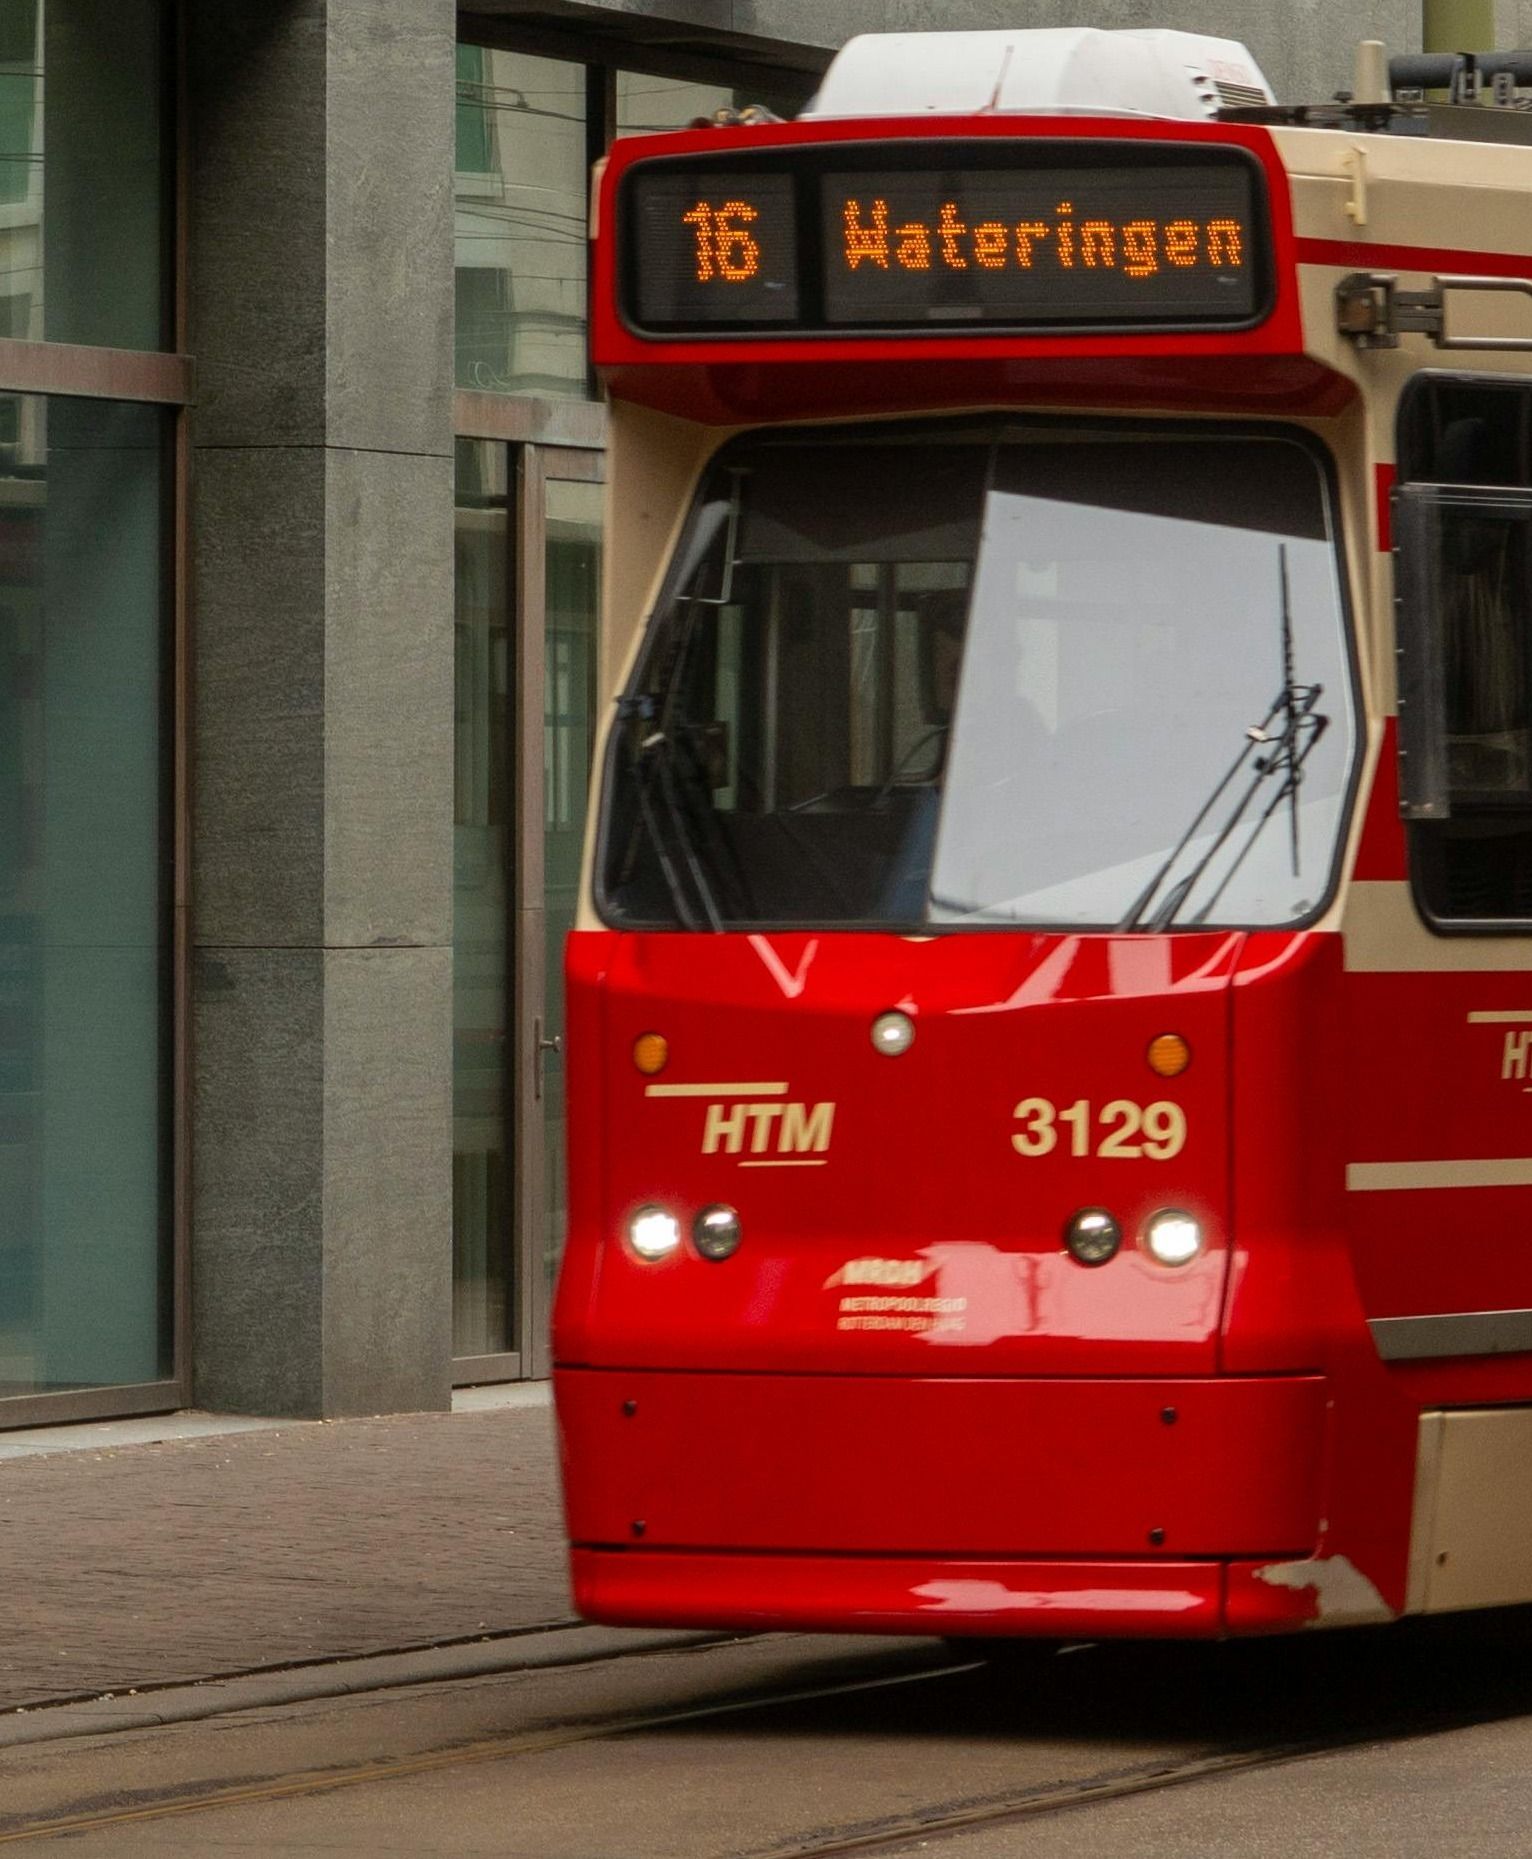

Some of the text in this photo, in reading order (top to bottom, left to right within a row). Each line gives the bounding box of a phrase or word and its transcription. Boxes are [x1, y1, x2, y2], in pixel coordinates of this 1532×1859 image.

[682, 200, 1242, 281] 16 Wateringen
[702, 1101, 836, 1155] HTM
[1011, 1097, 1187, 1160] 3129
